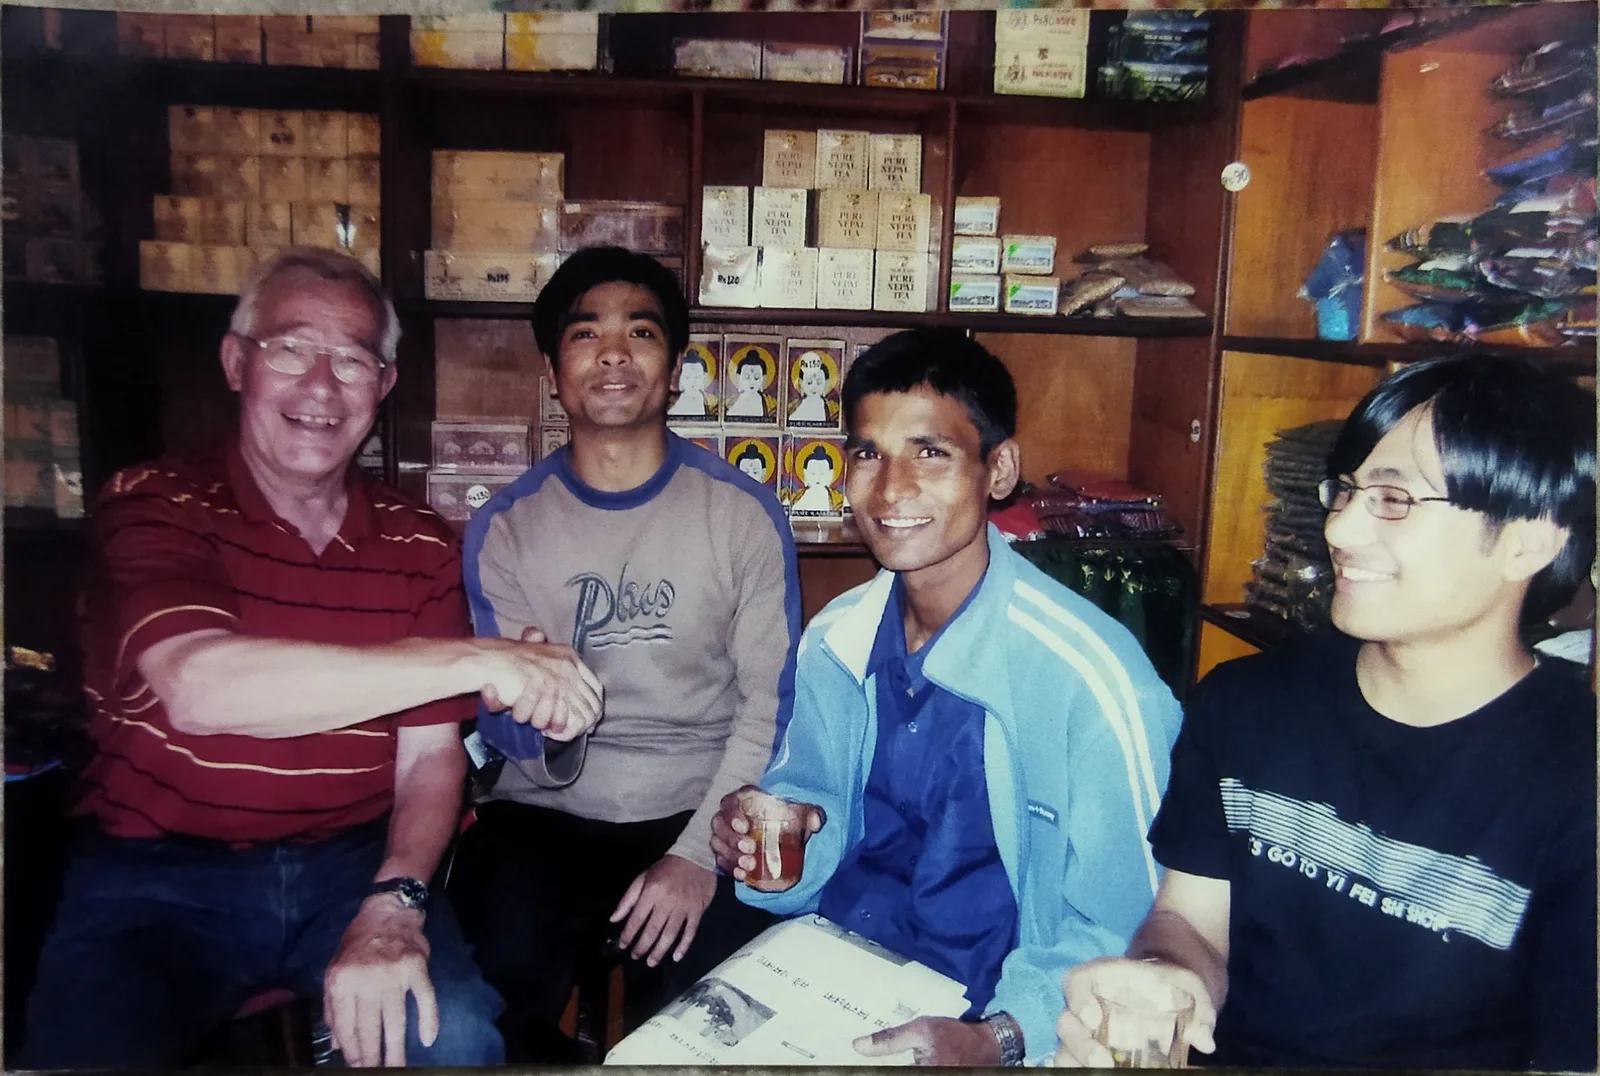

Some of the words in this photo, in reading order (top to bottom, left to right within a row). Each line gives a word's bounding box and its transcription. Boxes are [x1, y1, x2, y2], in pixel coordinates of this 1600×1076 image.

[830, 153, 854, 161] PURE
[883, 157, 908, 166] PURE
[881, 165, 908, 174] NEPAL
[834, 170, 850, 179] TEA
[888, 174, 904, 182] TEA
[767, 211, 790, 219] PURE
[765, 219, 792, 227] NEPAL
[889, 274, 915, 283] PURE
[887, 283, 915, 291] NEPAL
[893, 292, 910, 300] TEA
[1267, 846, 1297, 867] GO
[1299, 857, 1318, 879] TO
[1326, 871, 1346, 892] YI
